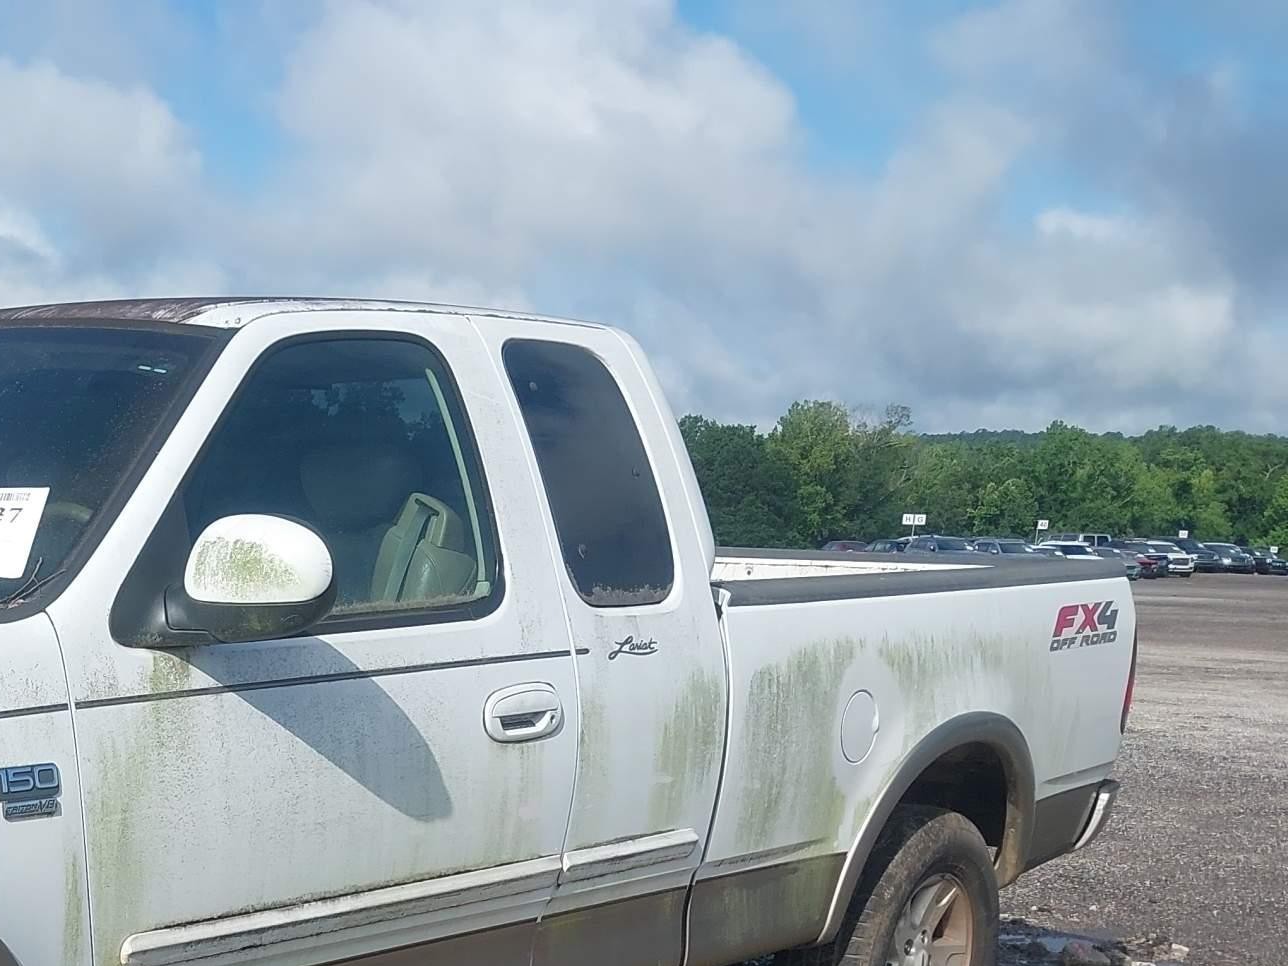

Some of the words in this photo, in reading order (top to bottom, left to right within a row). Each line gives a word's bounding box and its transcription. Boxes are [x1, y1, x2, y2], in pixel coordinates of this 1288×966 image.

[1052, 600, 1119, 638] FX4
[608, 635, 658, 660] Lariat
[1049, 636, 1078, 652] OFF
[1079, 630, 1118, 648] ROAD
